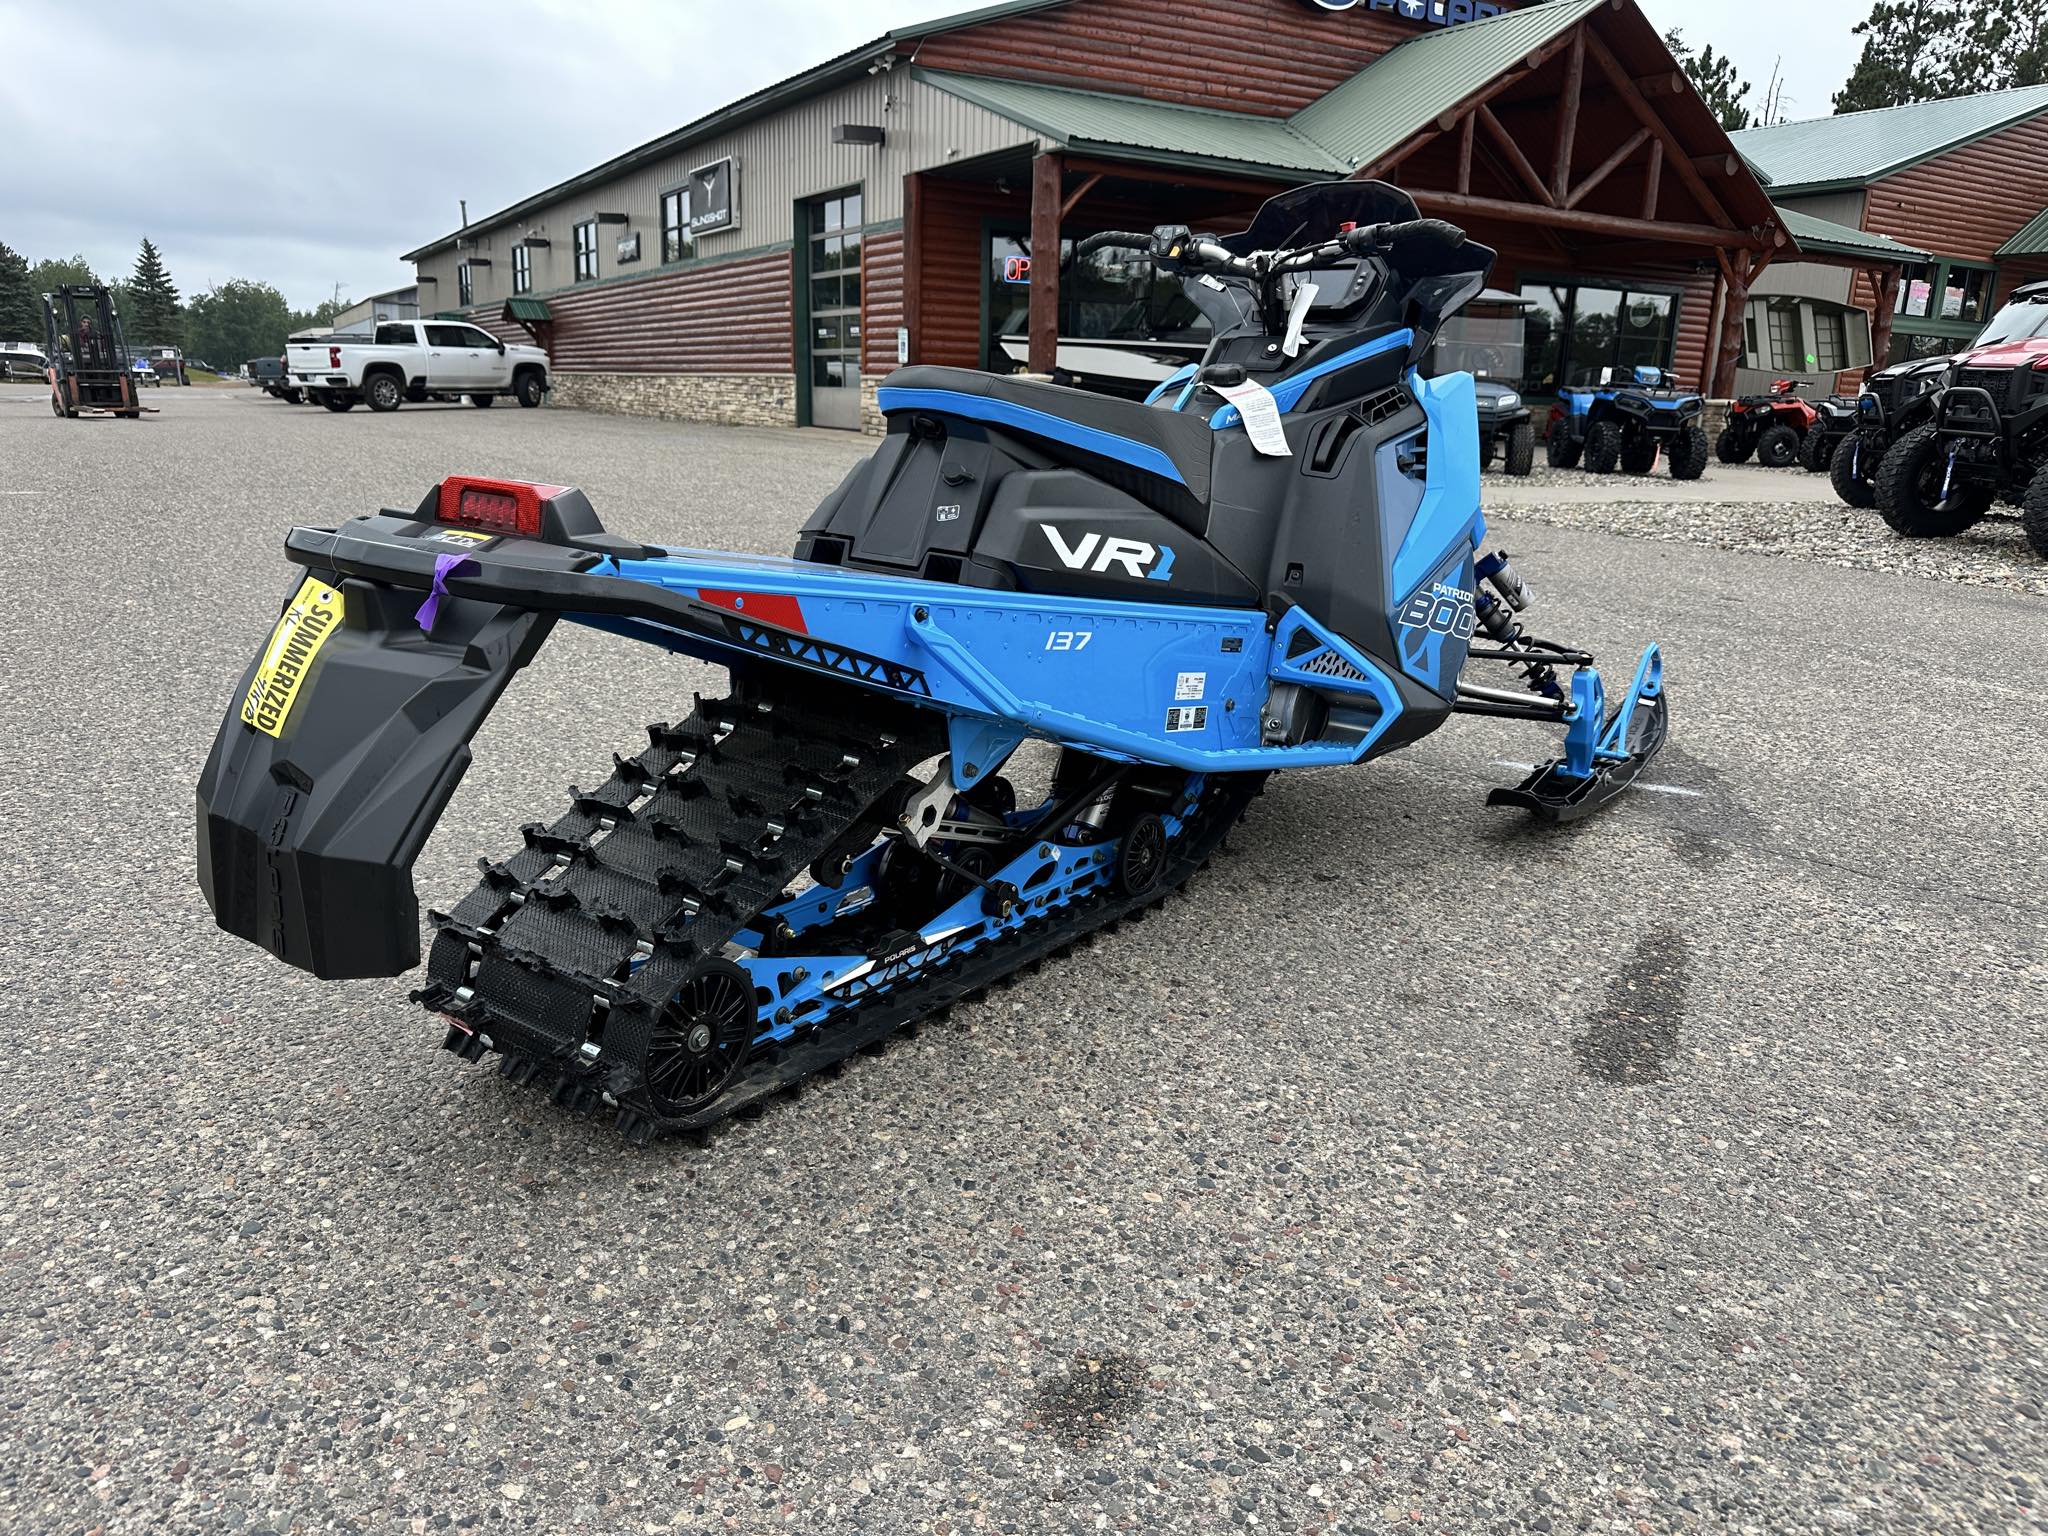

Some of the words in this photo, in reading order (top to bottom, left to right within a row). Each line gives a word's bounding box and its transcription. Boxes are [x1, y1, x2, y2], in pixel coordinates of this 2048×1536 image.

[691, 209, 727, 227] SLINGSHOT
[1007, 258, 1031, 280] OP
[1040, 523, 1176, 581] VR1
[1433, 583, 1474, 603] PATRIOT
[1398, 591, 1475, 640] 800
[1045, 631, 1092, 650] 137
[257, 604, 333, 731] SUMMERIZED
[884, 945, 917, 964] POLARIS
